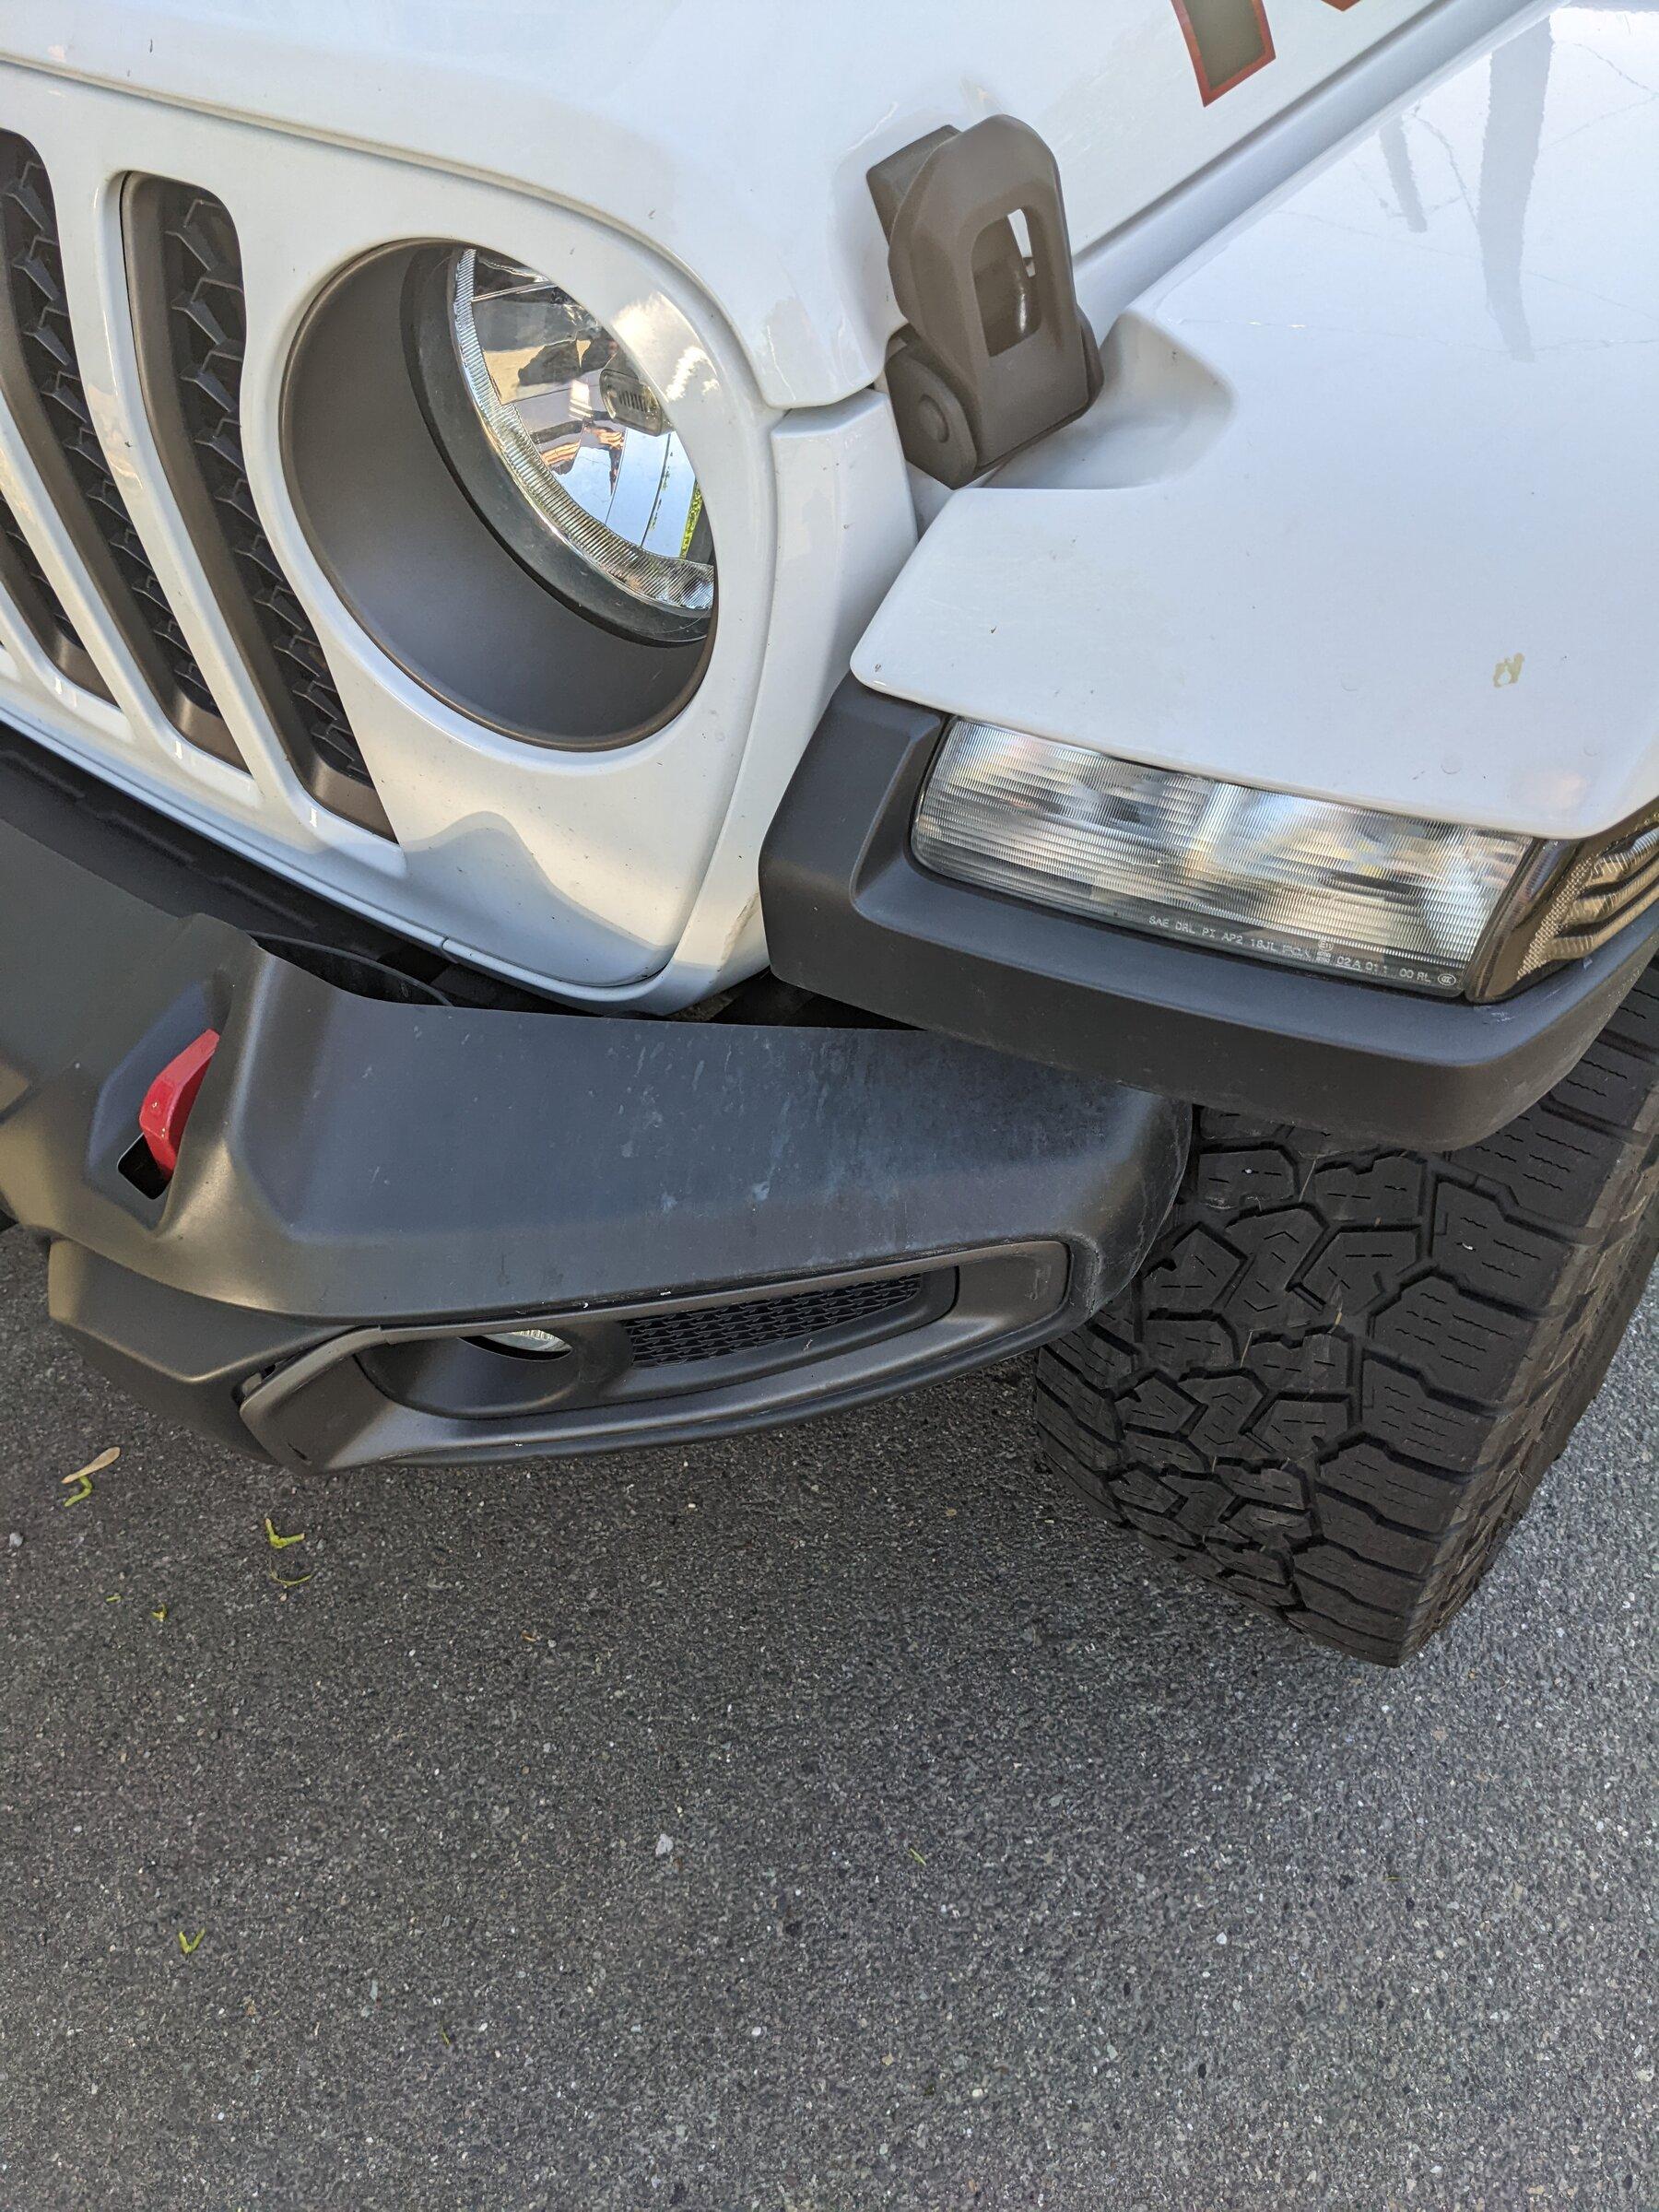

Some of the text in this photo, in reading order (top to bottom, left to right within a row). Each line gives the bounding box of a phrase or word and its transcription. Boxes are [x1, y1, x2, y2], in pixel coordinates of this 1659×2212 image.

[1148, 915, 1170, 928] SAE
[1175, 921, 1196, 935] DRL
[1221, 933, 1243, 945] AP2
